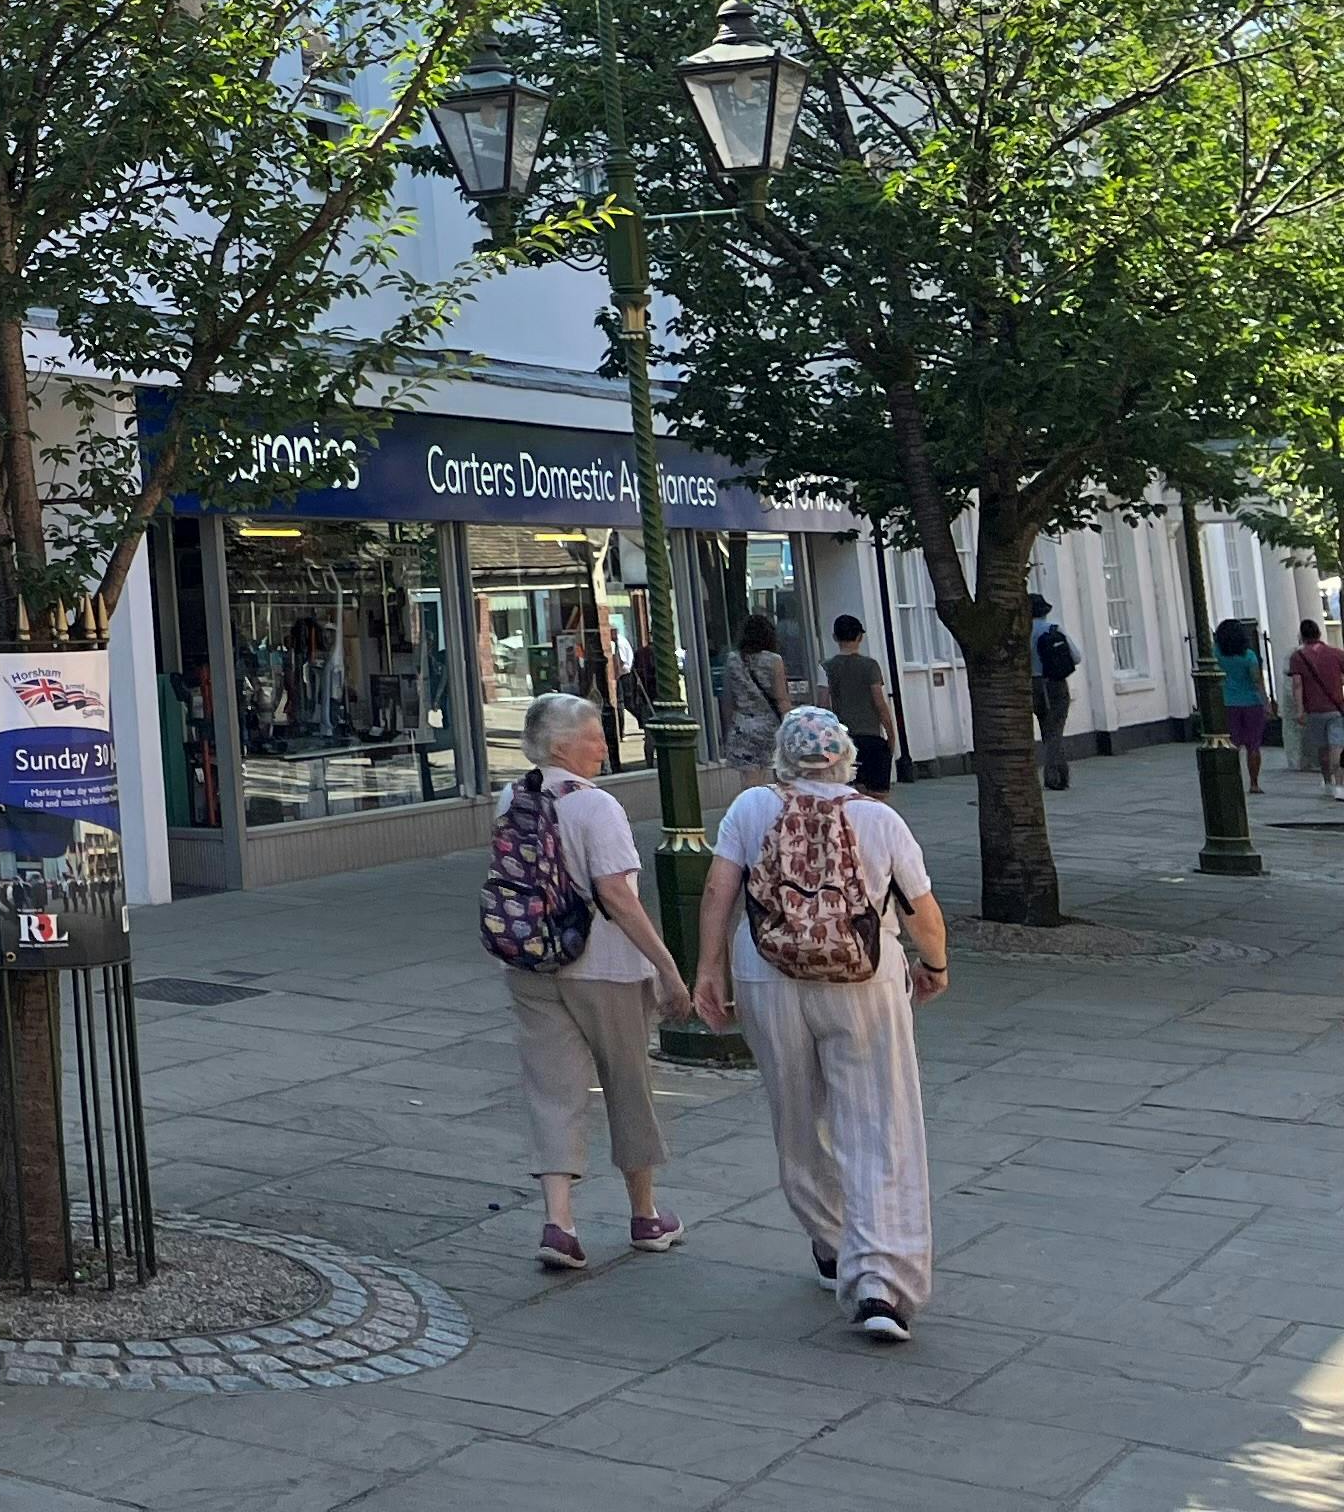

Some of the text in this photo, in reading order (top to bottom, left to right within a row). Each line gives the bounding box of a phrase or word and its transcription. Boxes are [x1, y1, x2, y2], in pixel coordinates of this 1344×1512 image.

[427, 445, 717, 513] Carters Domestic Aliances
[12, 668, 62, 684] Horsham
[15, 747, 89, 775] Sunday
[94, 744, 109, 767] 30
